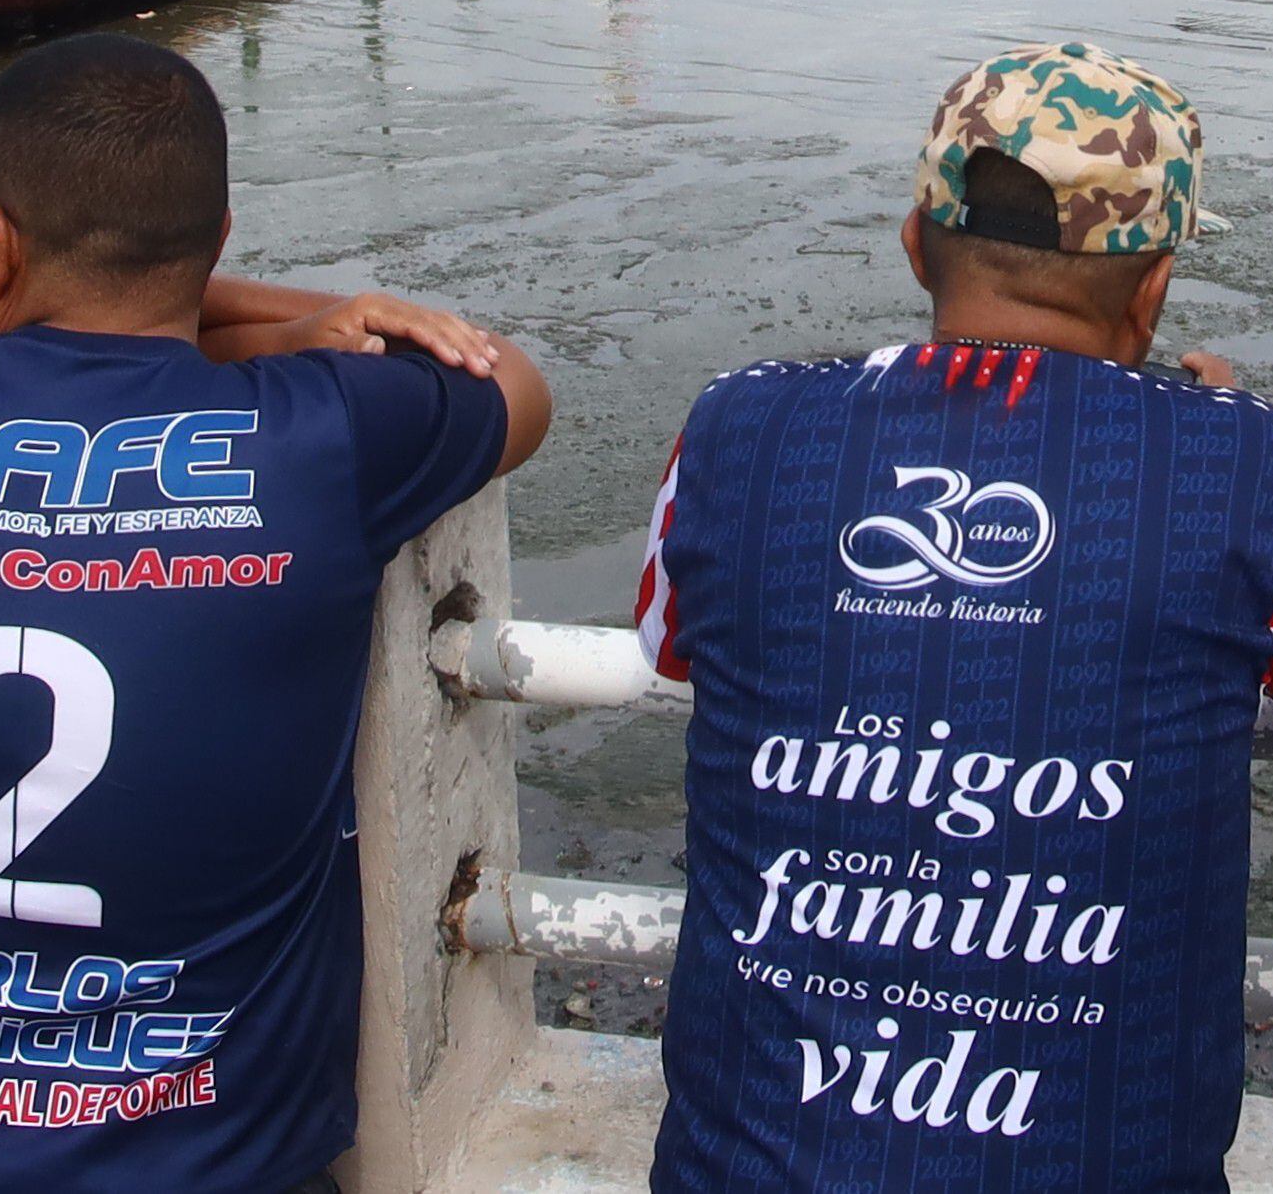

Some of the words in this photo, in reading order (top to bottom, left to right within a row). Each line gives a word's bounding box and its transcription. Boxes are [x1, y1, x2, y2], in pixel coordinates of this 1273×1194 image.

[883, 412, 939, 438] 1992
[1081, 423, 1138, 447] 1992
[1180, 435, 1233, 456] 2022
[1078, 459, 1134, 486] 1992
[1176, 473, 1228, 495] 2022
[54, 512, 91, 535] FE
[90, 512, 114, 534] Y
[114, 506, 264, 534] ESPERANZA
[1074, 498, 1132, 526] 1992
[1172, 511, 1225, 534] 2022
[838, 465, 1056, 591] 30
[1069, 538, 1128, 566] 1992
[1169, 551, 1221, 574] 2022
[1064, 578, 1123, 606] 1992
[834, 588, 946, 619] haciendo
[949, 595, 1056, 625] historia
[1060, 619, 1117, 648] 1992
[857, 650, 913, 678] 1992
[955, 656, 1014, 684] 2022
[1055, 661, 1112, 690] 1992
[834, 705, 904, 739] Los
[951, 698, 1009, 725] 2022
[1051, 703, 1108, 732] 1992
[750, 720, 1134, 839] amigos
[825, 848, 894, 877] son
[906, 849, 942, 882] la
[732, 848, 1126, 966] familia
[737, 954, 793, 989] que
[804, 973, 870, 1001] nos
[882, 980, 1060, 1026] obsequió
[1071, 995, 1106, 1025] la
[794, 1017, 1041, 1137] vida
[44, 1057, 217, 1128] DEPORTE
